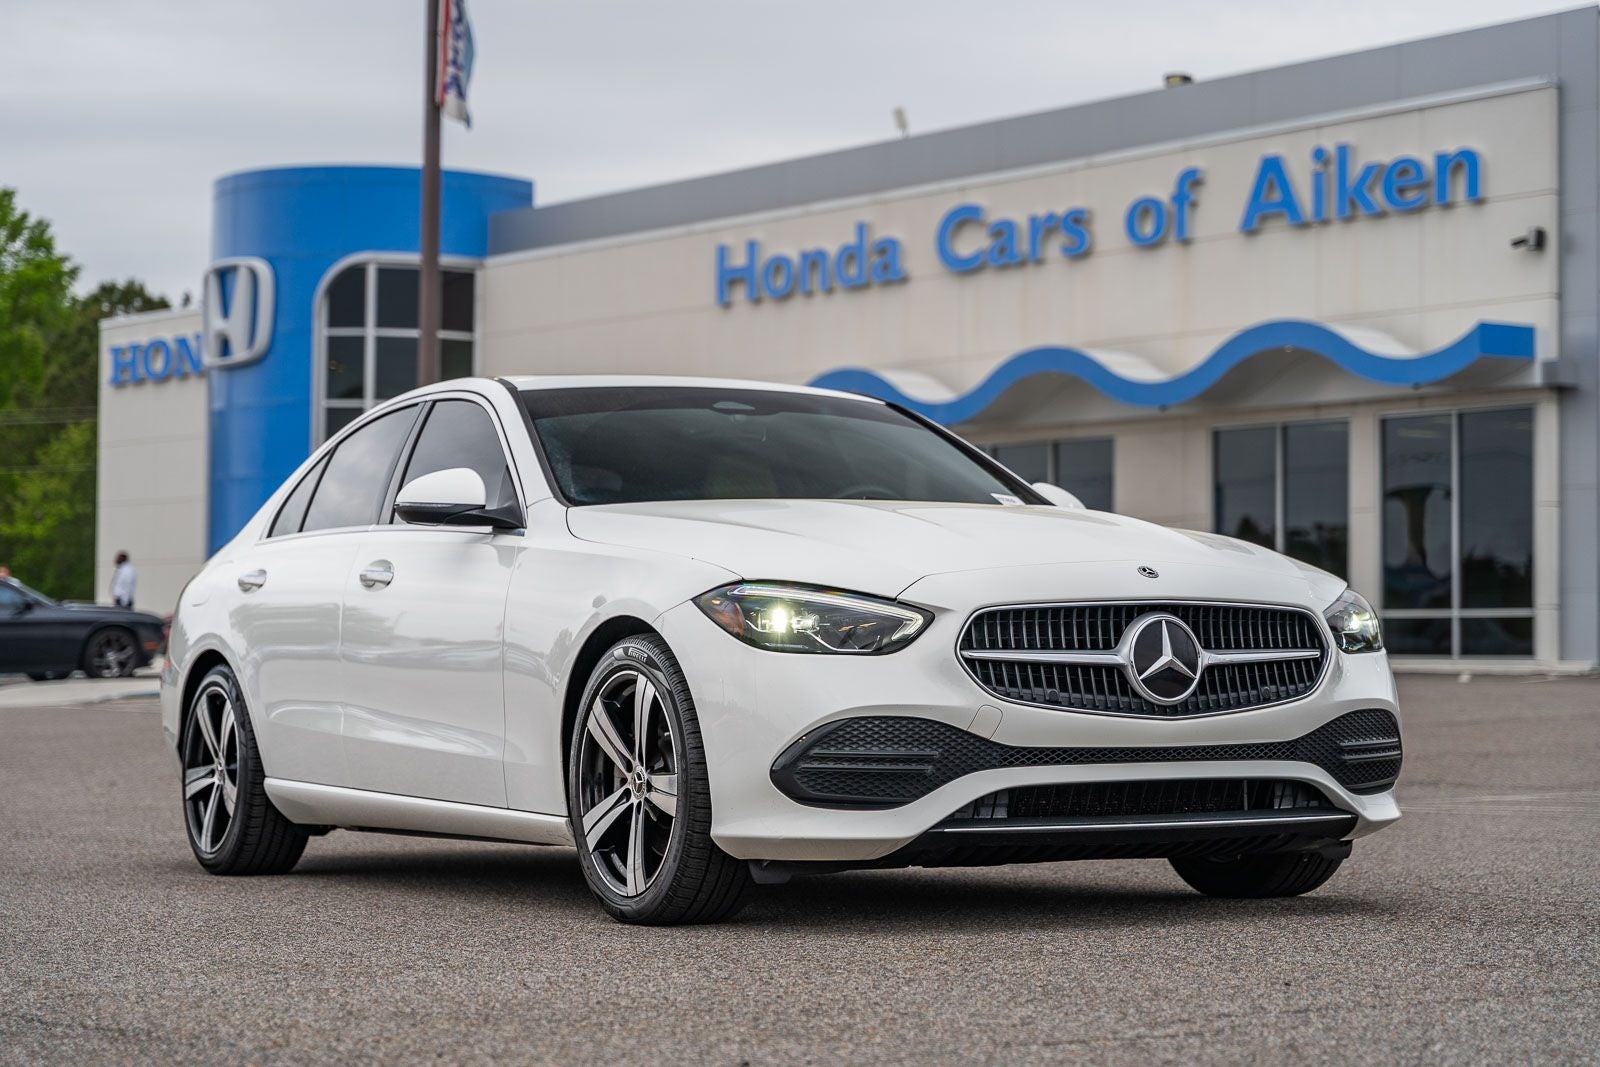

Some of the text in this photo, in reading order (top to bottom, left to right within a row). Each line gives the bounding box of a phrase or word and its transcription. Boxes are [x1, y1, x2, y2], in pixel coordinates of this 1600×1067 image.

[715, 143, 1483, 308] Honda Cars of Aiken
